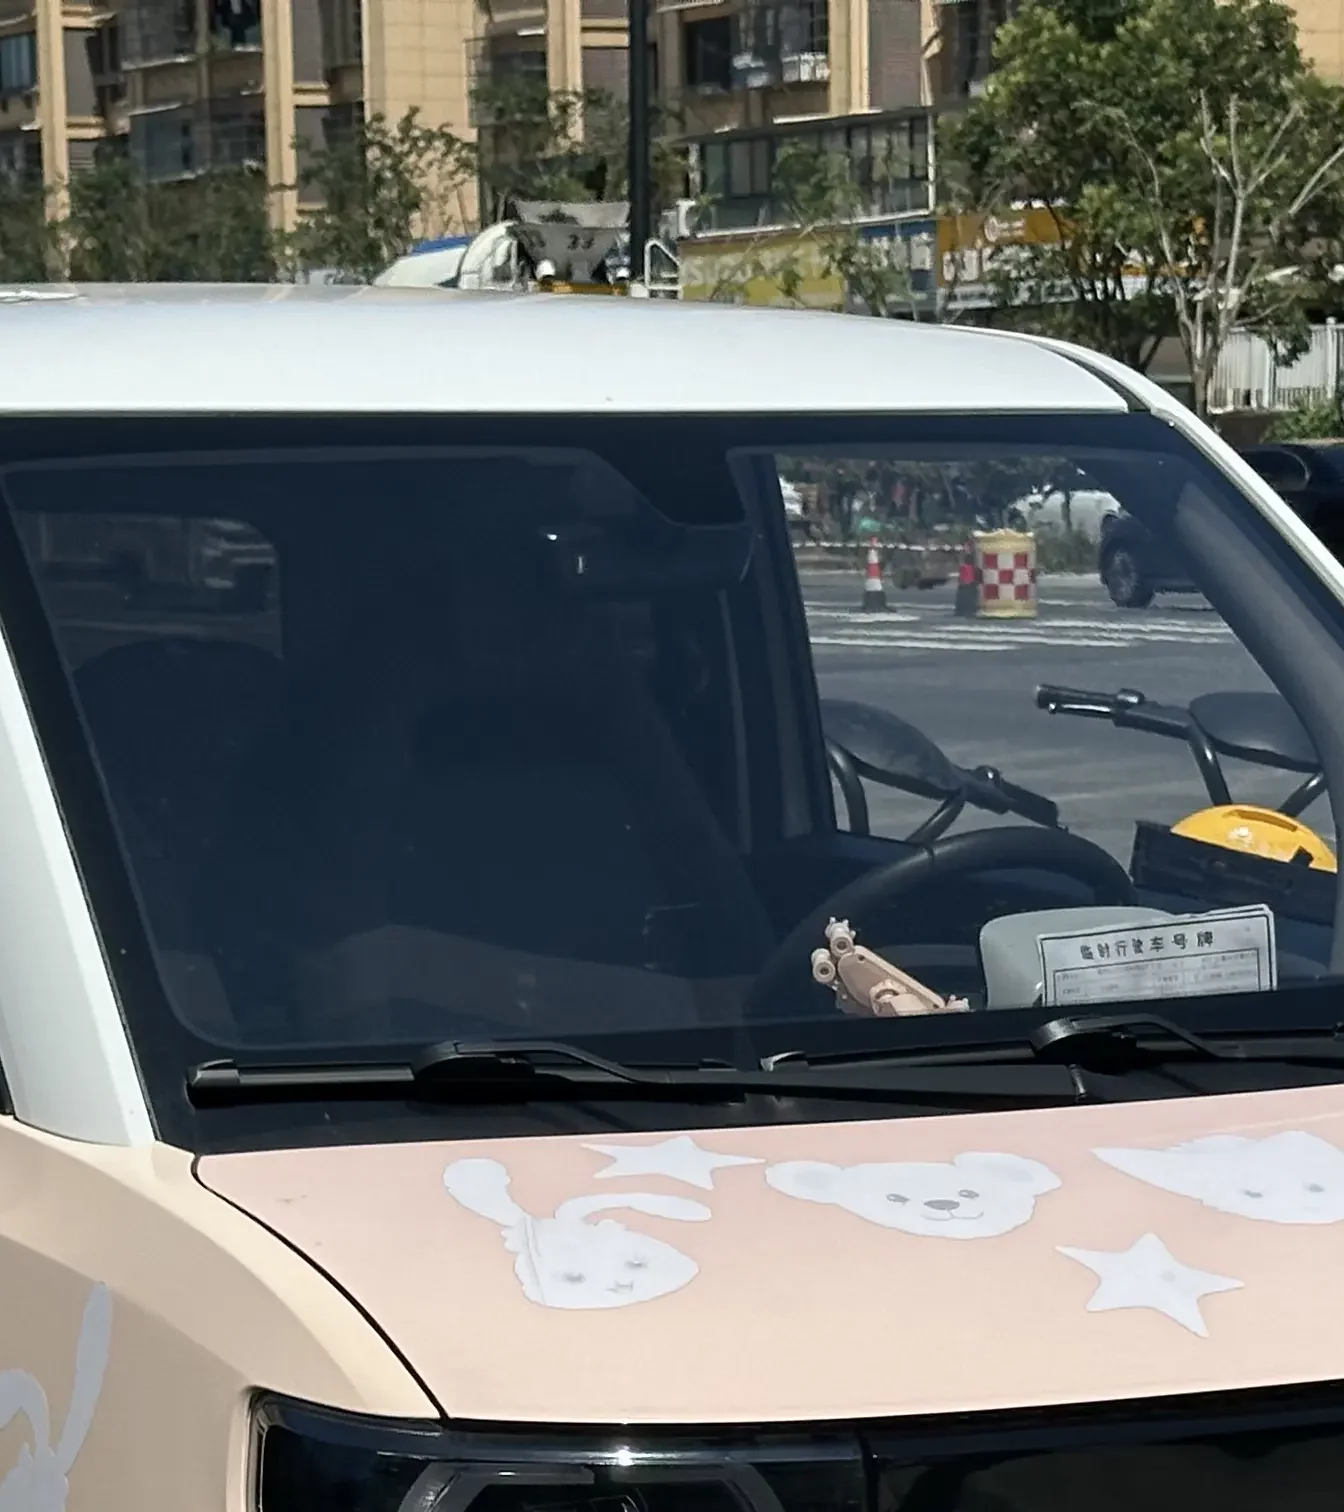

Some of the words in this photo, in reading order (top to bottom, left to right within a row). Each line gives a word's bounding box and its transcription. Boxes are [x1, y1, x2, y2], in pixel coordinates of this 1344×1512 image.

[1080, 931, 1213, 960] 临时行驶车号牌
